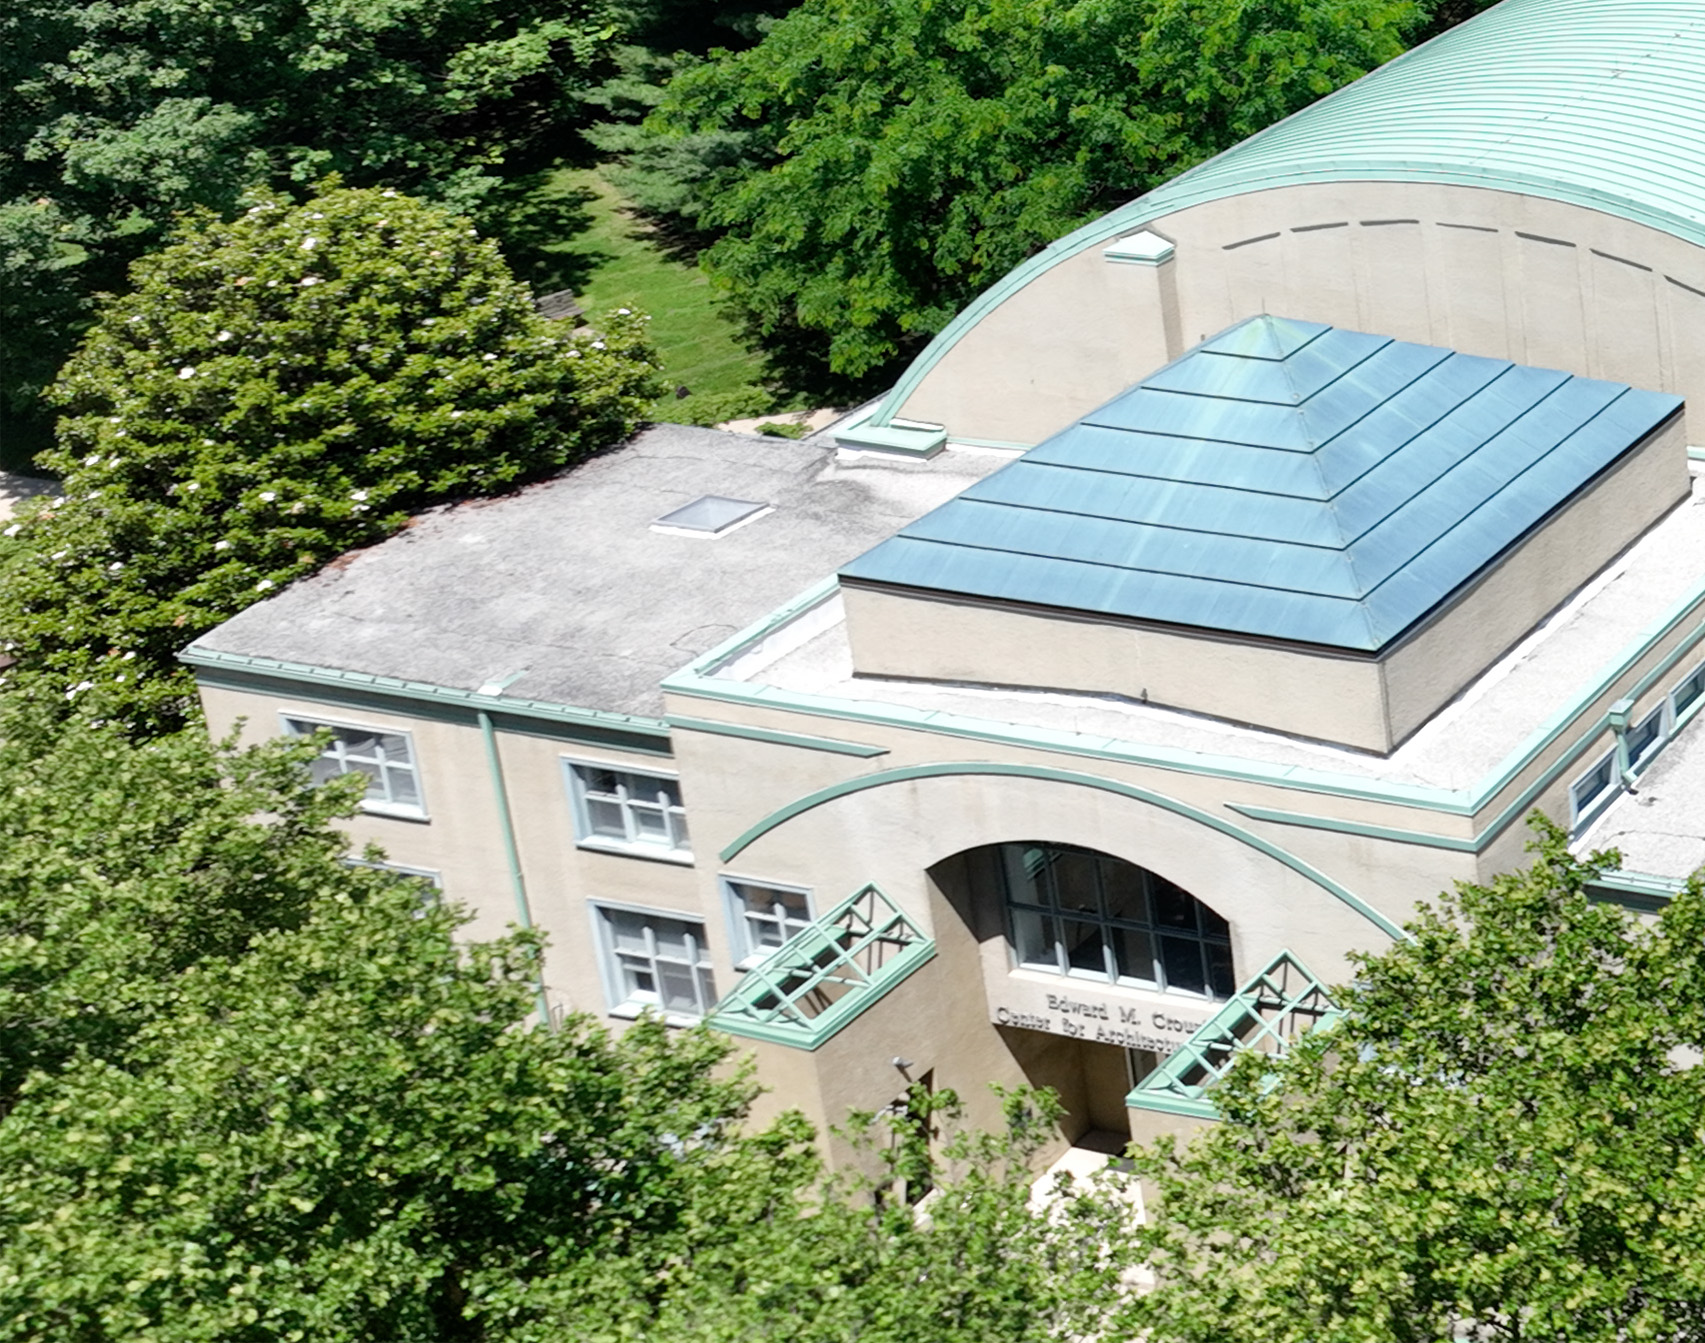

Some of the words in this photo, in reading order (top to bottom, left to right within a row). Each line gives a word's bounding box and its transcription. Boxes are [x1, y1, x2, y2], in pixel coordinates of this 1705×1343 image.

[996, 1006, 1051, 1031] Center
[1061, 1016, 1086, 1038] for
[1046, 993, 1110, 1021] Edward
[1118, 1005, 1142, 1027] M.
